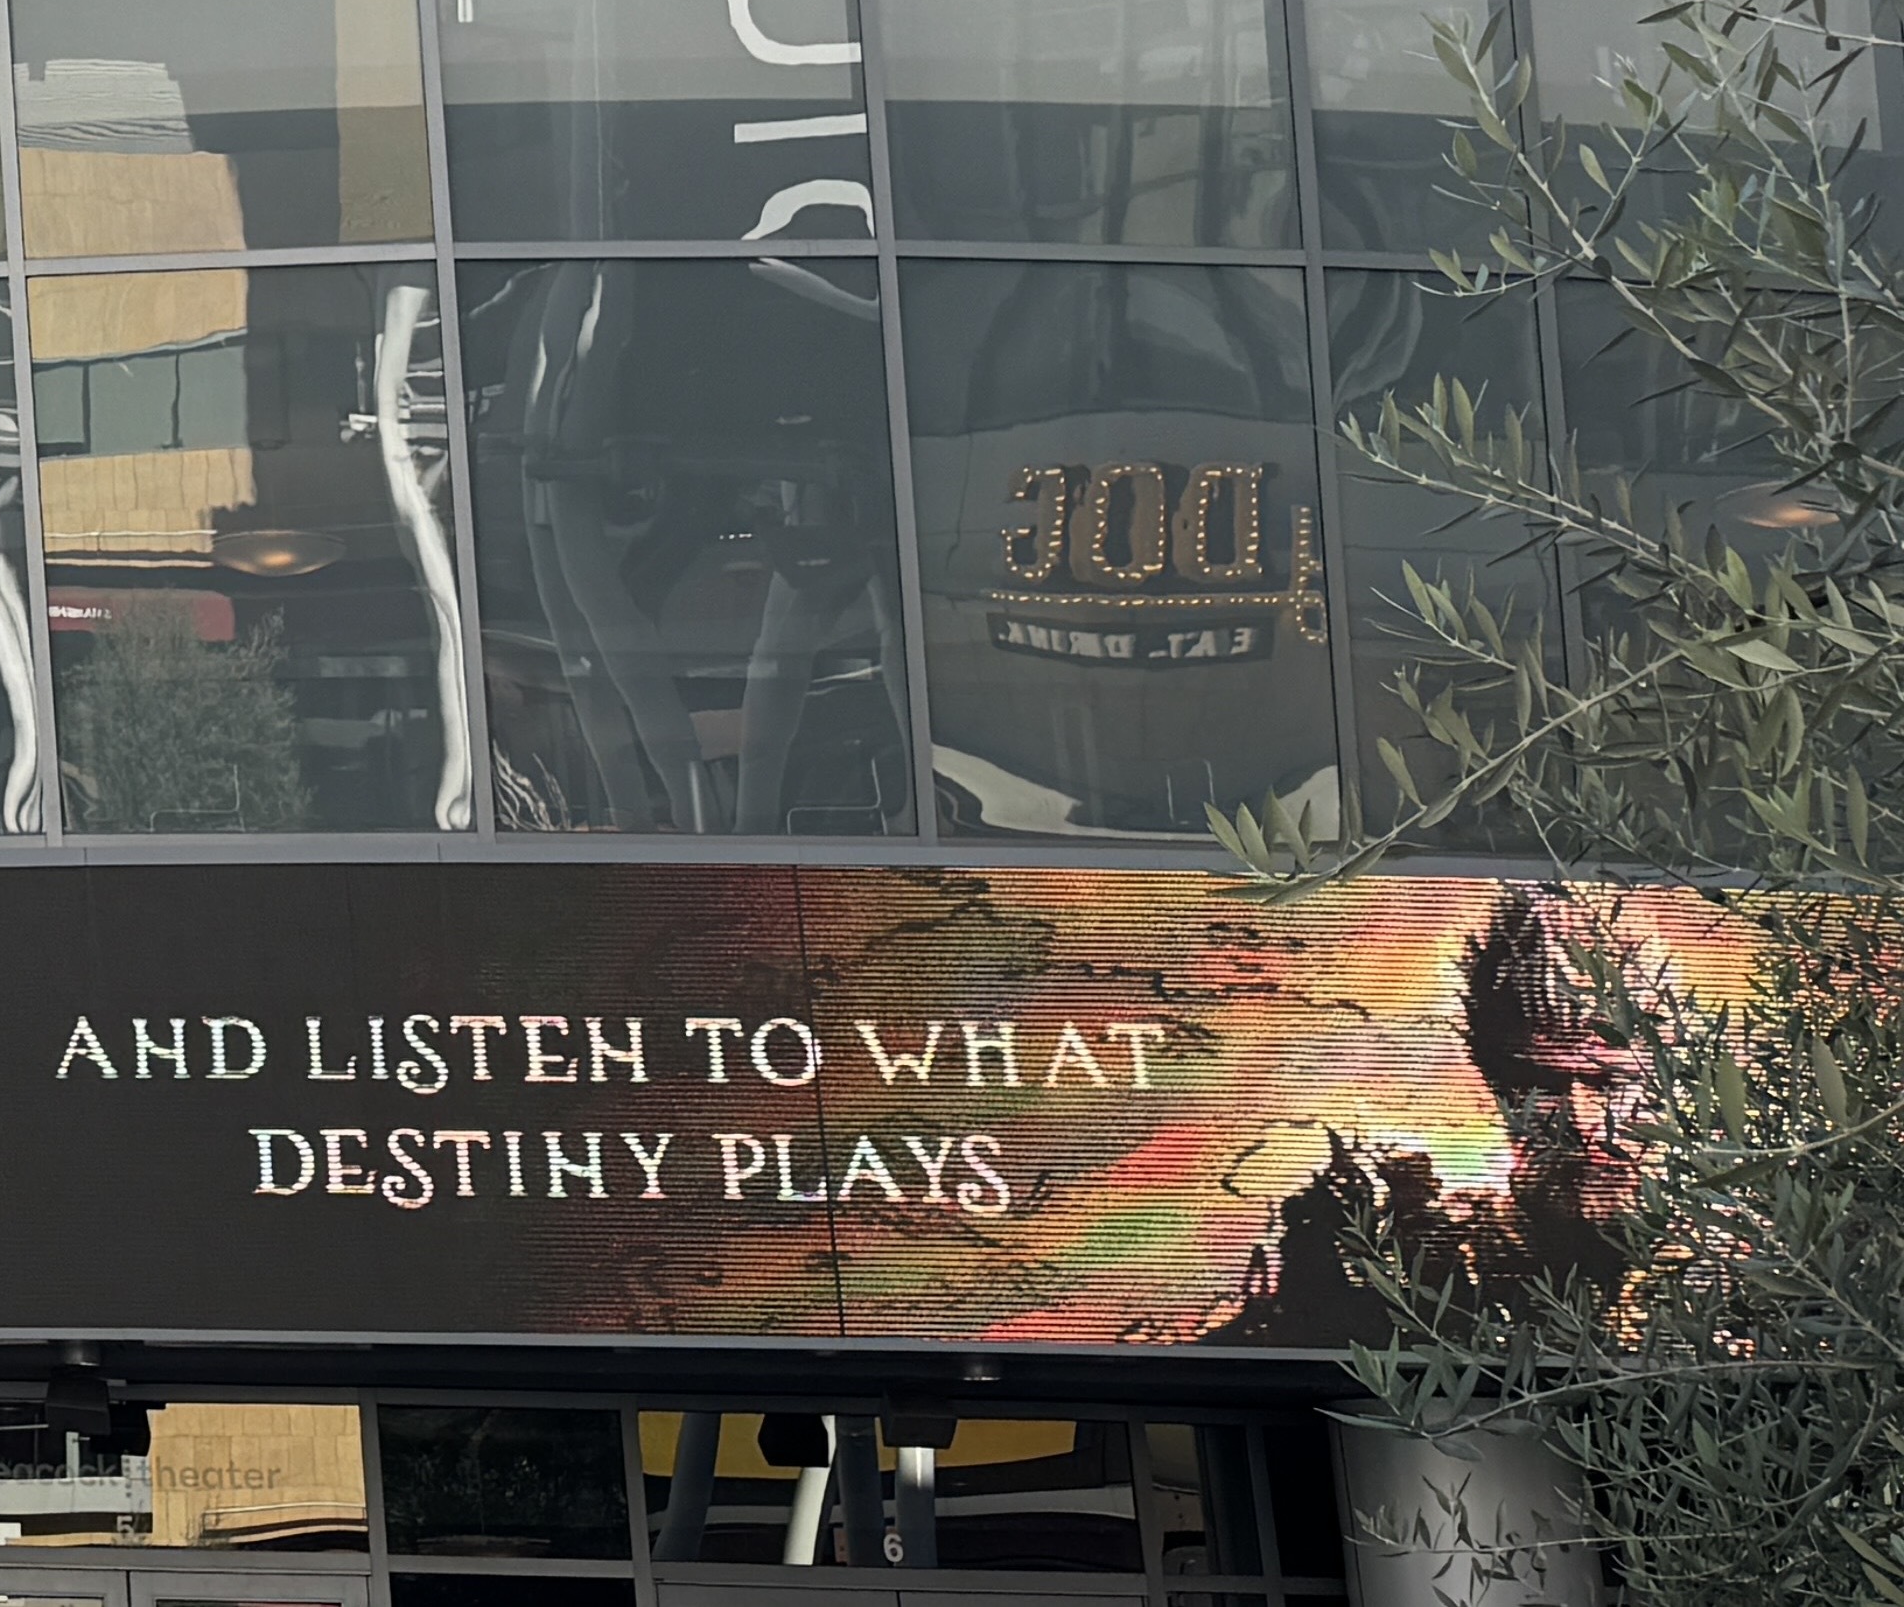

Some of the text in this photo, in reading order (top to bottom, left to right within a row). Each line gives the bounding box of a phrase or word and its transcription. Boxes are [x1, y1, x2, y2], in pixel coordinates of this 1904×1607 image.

[55, 1013, 1168, 1094] AND LISTEN TO WHAT
[249, 1127, 1013, 1214] DESTINY PLAYS
[142, 1455, 282, 1491] theater
[116, 1515, 135, 1537] 5
[882, 1533, 904, 1562] 6
